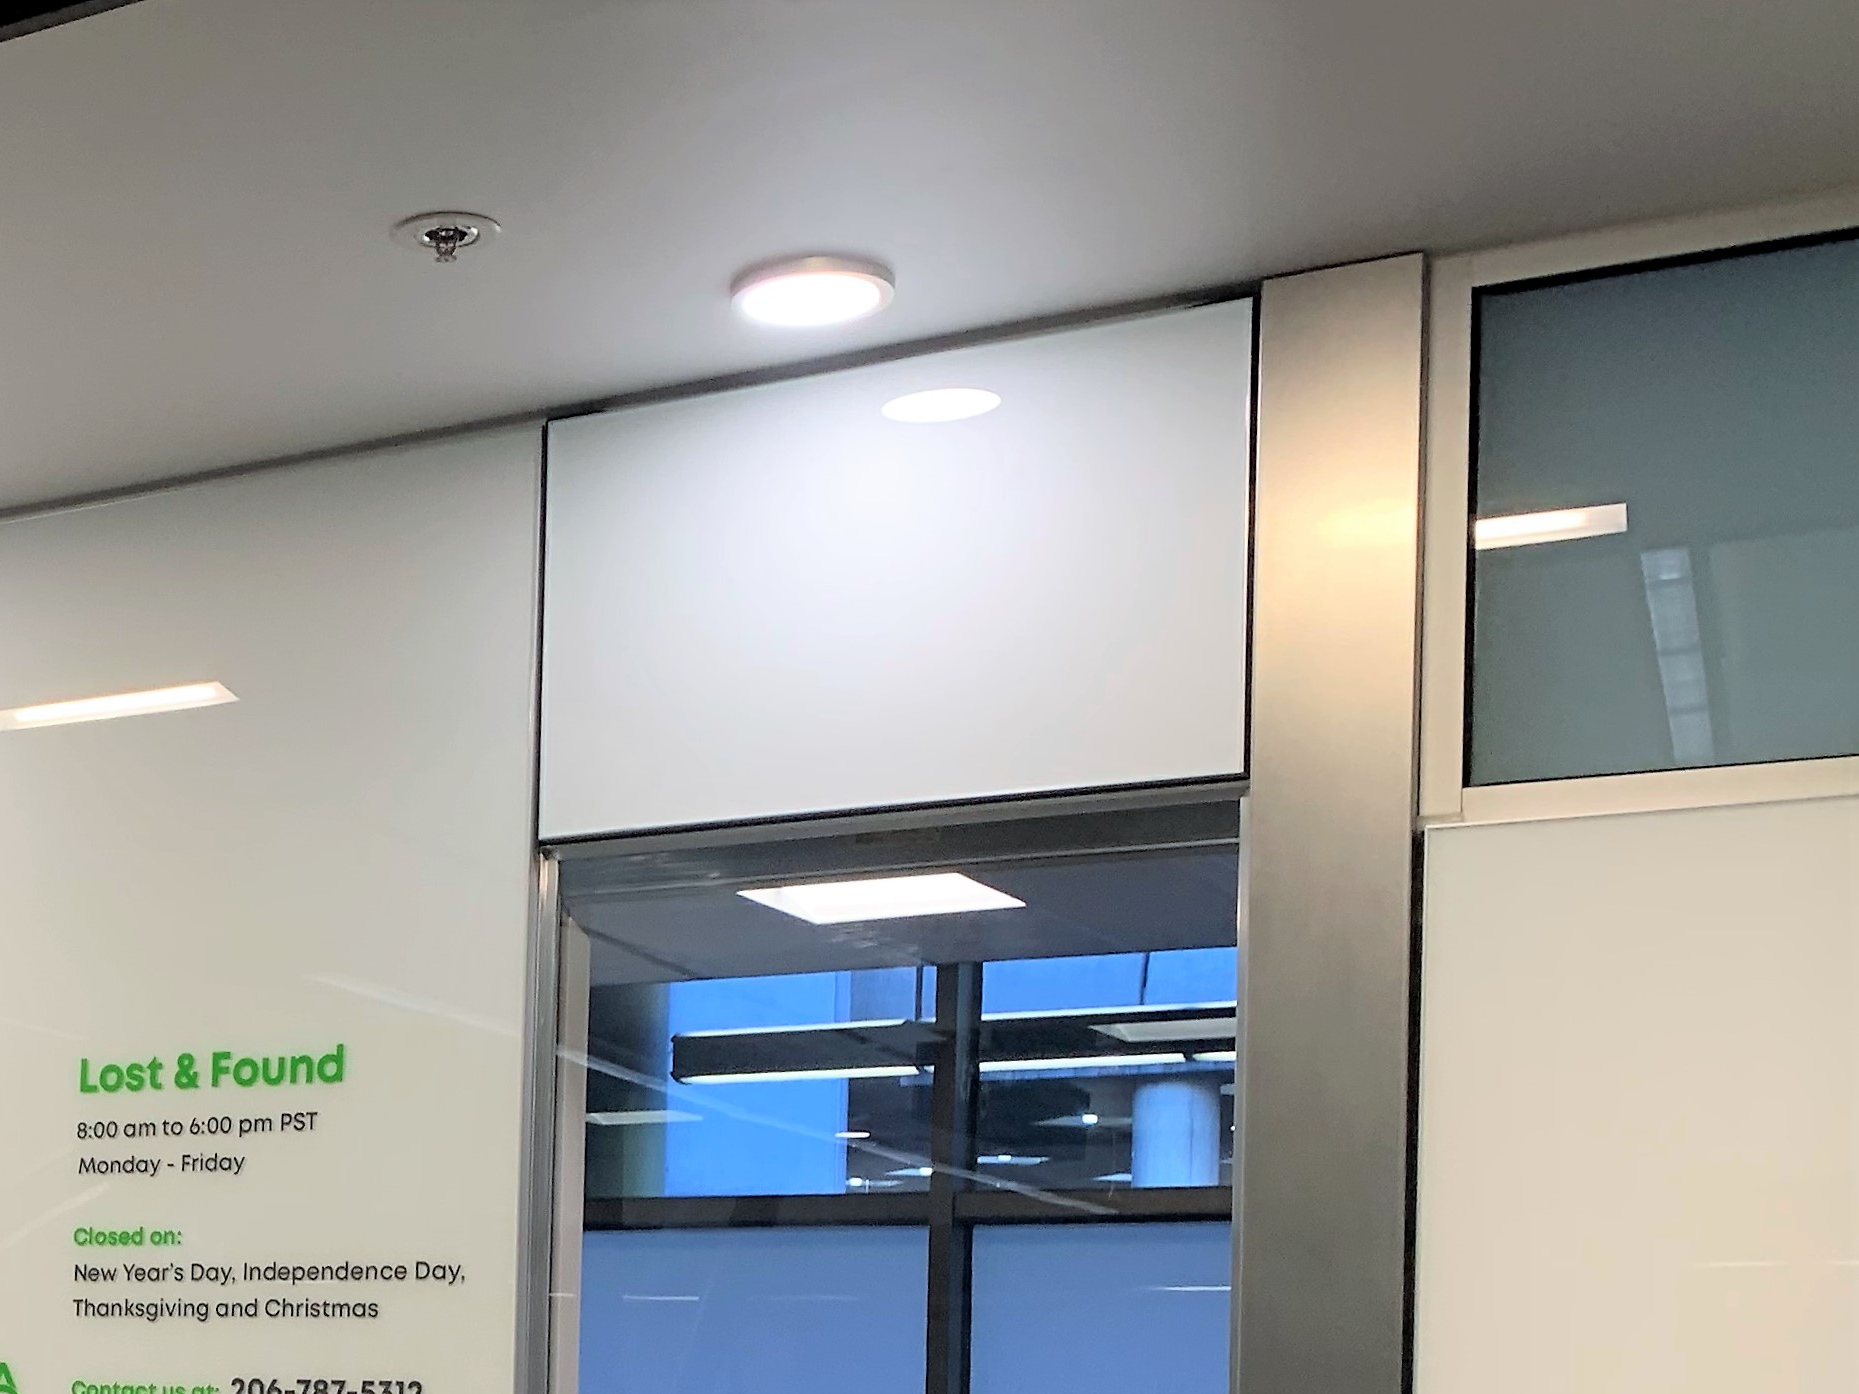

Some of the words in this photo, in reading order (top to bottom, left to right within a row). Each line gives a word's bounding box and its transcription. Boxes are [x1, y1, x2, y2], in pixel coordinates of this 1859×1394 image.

[80, 1057, 164, 1093] Lost
[174, 1053, 199, 1089] &
[212, 1044, 345, 1087] Found
[77, 1121, 118, 1139] 8:00
[124, 1123, 156, 1137] am
[163, 1120, 183, 1135] to
[190, 1117, 231, 1135] 6:00
[239, 1118, 272, 1137] pm
[281, 1112, 317, 1131] PST
[79, 1156, 160, 1177] Monday
[182, 1153, 245, 1175] Friday
[74, 1227, 145, 1246] Closed
[150, 1231, 181, 1245] on:
[75, 1264, 116, 1281] New
[191, 1264, 235, 1285] Day,
[244, 1261, 407, 1285] Independence
[416, 1262, 464, 1285] Day,
[73, 1298, 208, 1322] Thanksgiving
[216, 1298, 257, 1317] and
[265, 1298, 378, 1317] Christmas
